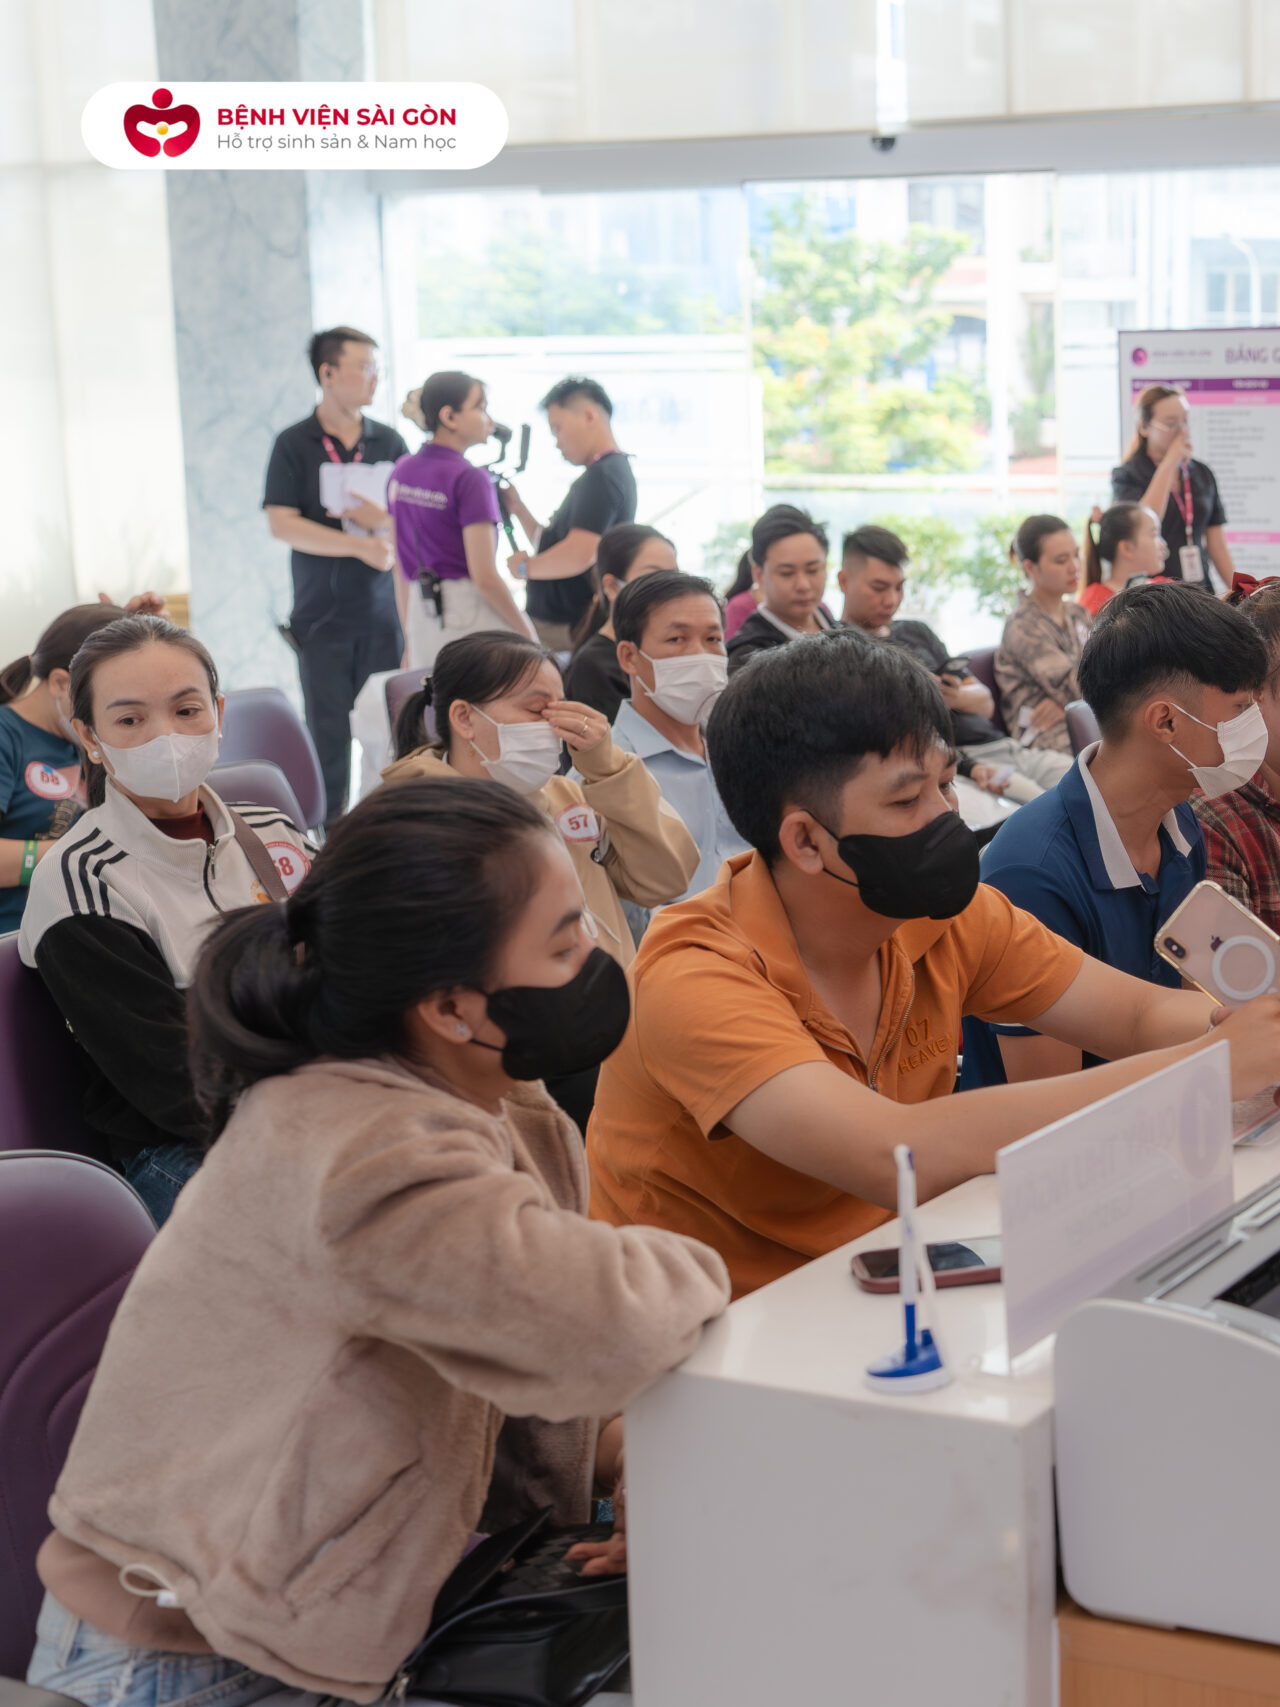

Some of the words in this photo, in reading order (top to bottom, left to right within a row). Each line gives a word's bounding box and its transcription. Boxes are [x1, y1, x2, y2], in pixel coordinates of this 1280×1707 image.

[1225, 343, 1268, 364] BẢNG
[568, 813, 588, 831] 57
[905, 1016, 929, 1047] 07
